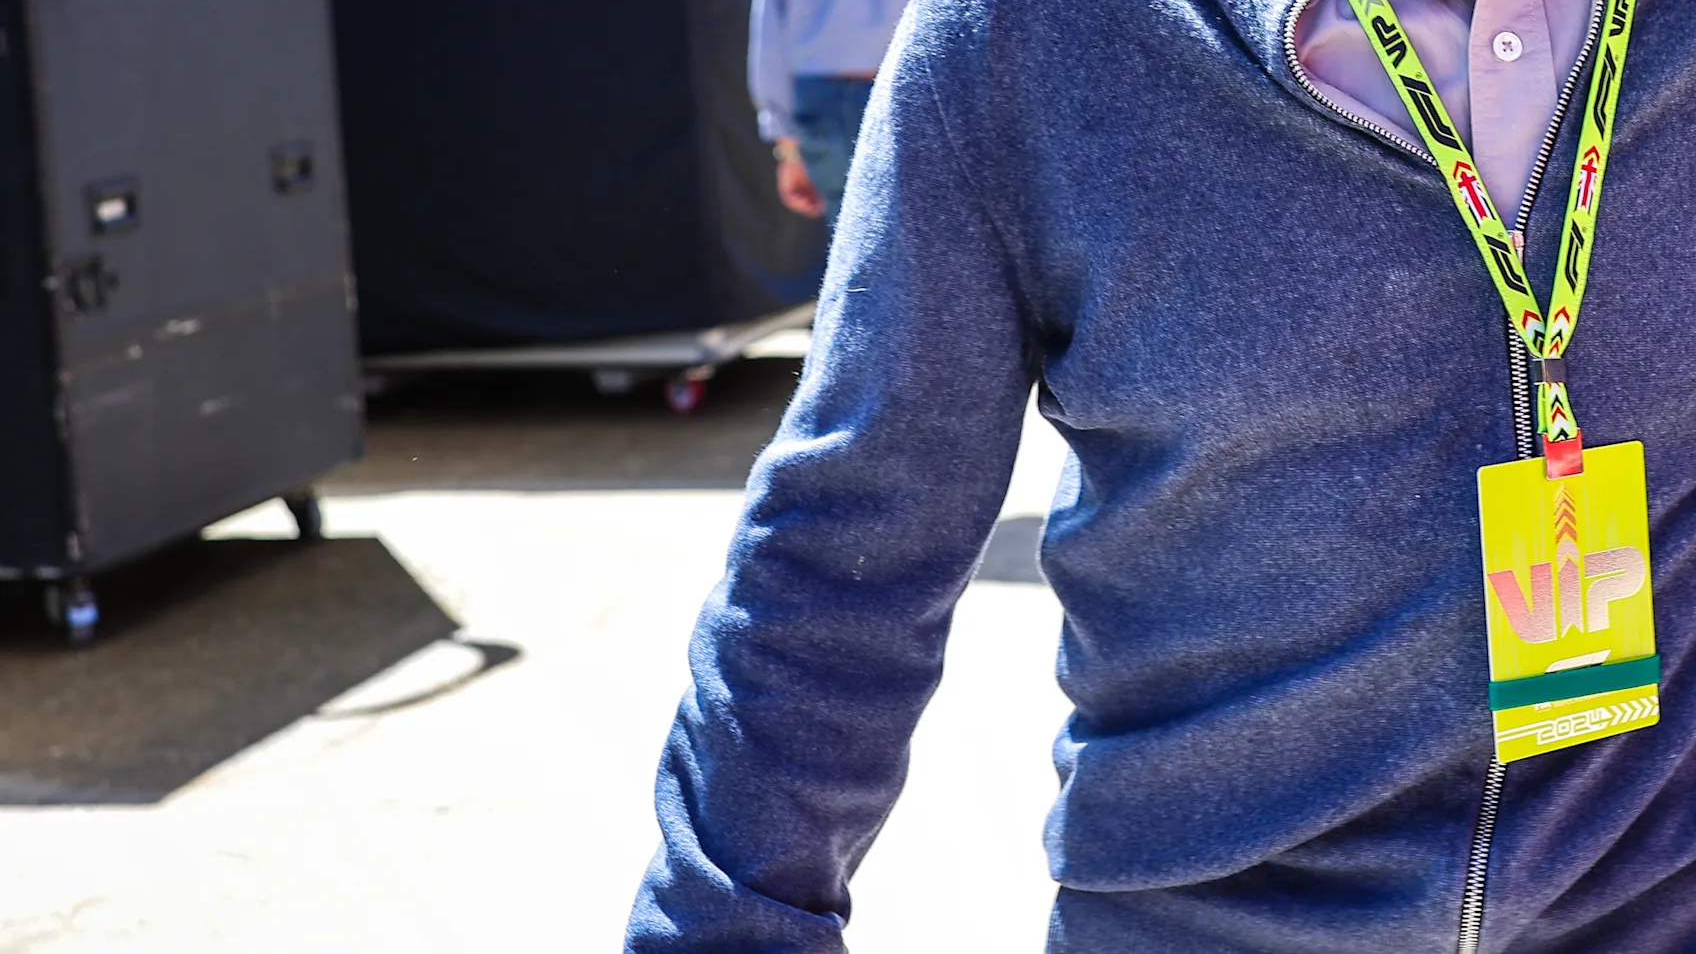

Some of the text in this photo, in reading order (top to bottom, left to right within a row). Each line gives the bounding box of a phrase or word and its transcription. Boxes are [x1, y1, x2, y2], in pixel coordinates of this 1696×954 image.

[1371, 14, 1409, 68] VIP
[1487, 546, 1647, 645] VIP
[1536, 706, 1613, 746] 2024
